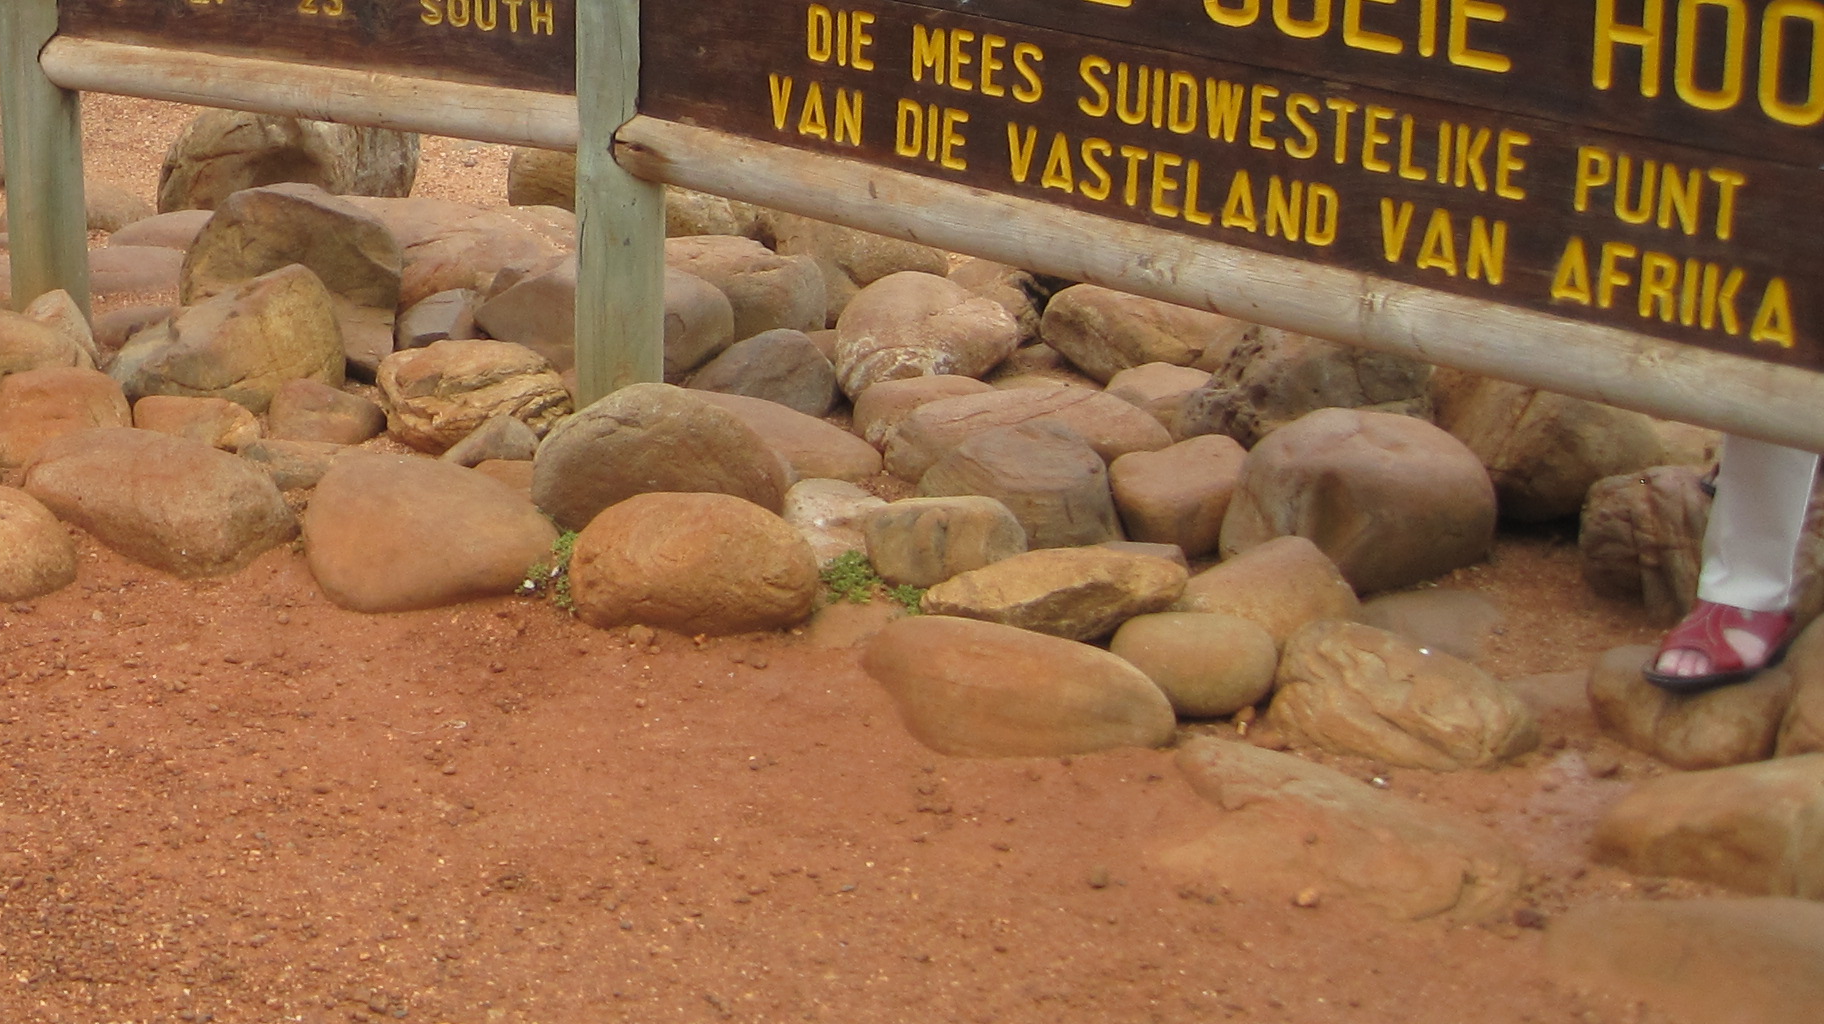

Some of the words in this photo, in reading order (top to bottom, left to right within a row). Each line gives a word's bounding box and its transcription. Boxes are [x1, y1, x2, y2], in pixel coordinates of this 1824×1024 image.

[768, 72, 864, 148] VAN
[895, 97, 969, 171] DIE
[1006, 120, 1339, 248] VASTELAND
[1379, 196, 1508, 287] VAN
[1550, 236, 1797, 349] AFRIKA
[806, 3, 876, 72] DIE
[911, 22, 1044, 104] MEES
[1077, 53, 1531, 202] SUIDWESTELIKE
[1574, 145, 1747, 242] PUNT
